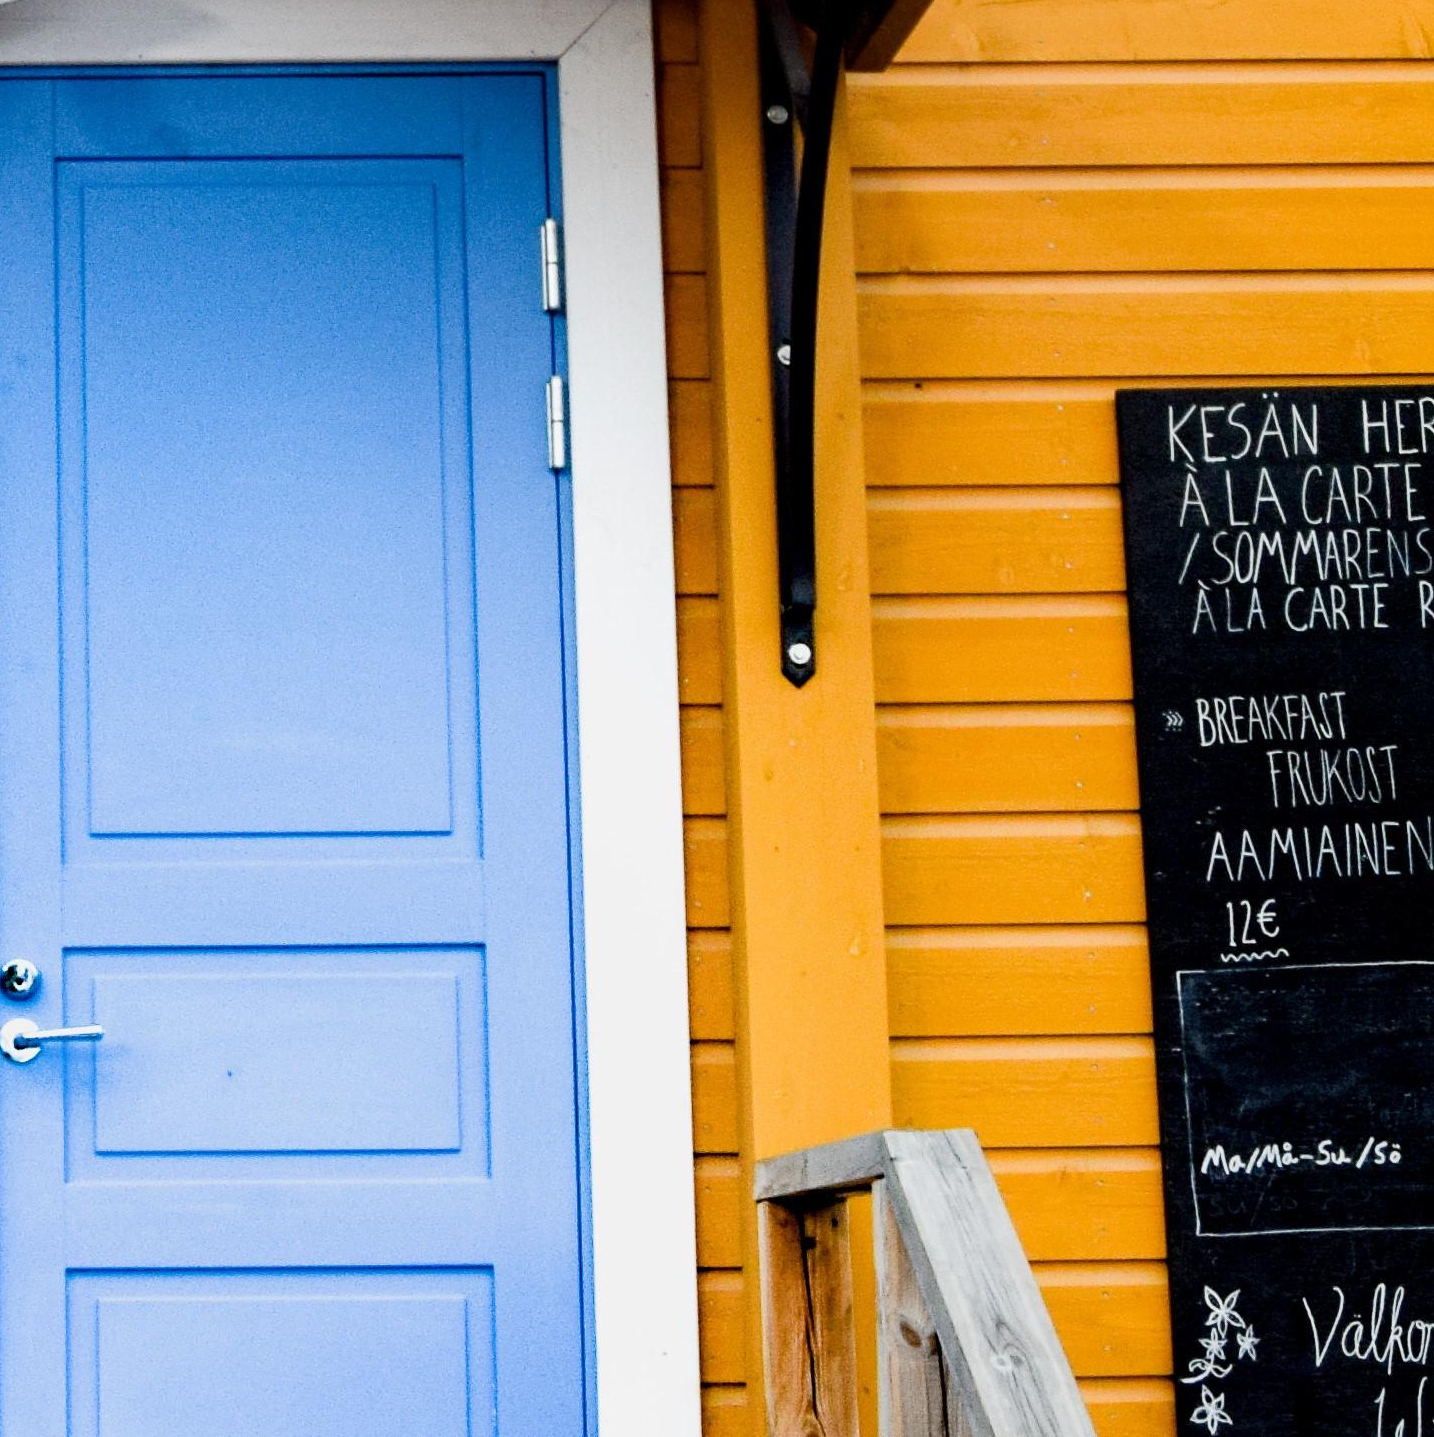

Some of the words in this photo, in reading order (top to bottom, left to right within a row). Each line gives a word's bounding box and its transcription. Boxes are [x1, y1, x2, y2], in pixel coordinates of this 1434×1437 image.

[1167, 392, 1319, 463] KESÄN
[1229, 466, 1286, 526] LA
[1301, 461, 1424, 525] CARTE
[1225, 586, 1267, 633] LA
[1284, 582, 1390, 632] CARTE
[1196, 690, 1347, 747] BREAKFAST
[1264, 745, 1398, 809] FRUKOST
[1205, 815, 1434, 882] AAMIAINEN
[1225, 898, 1280, 948] 12€
